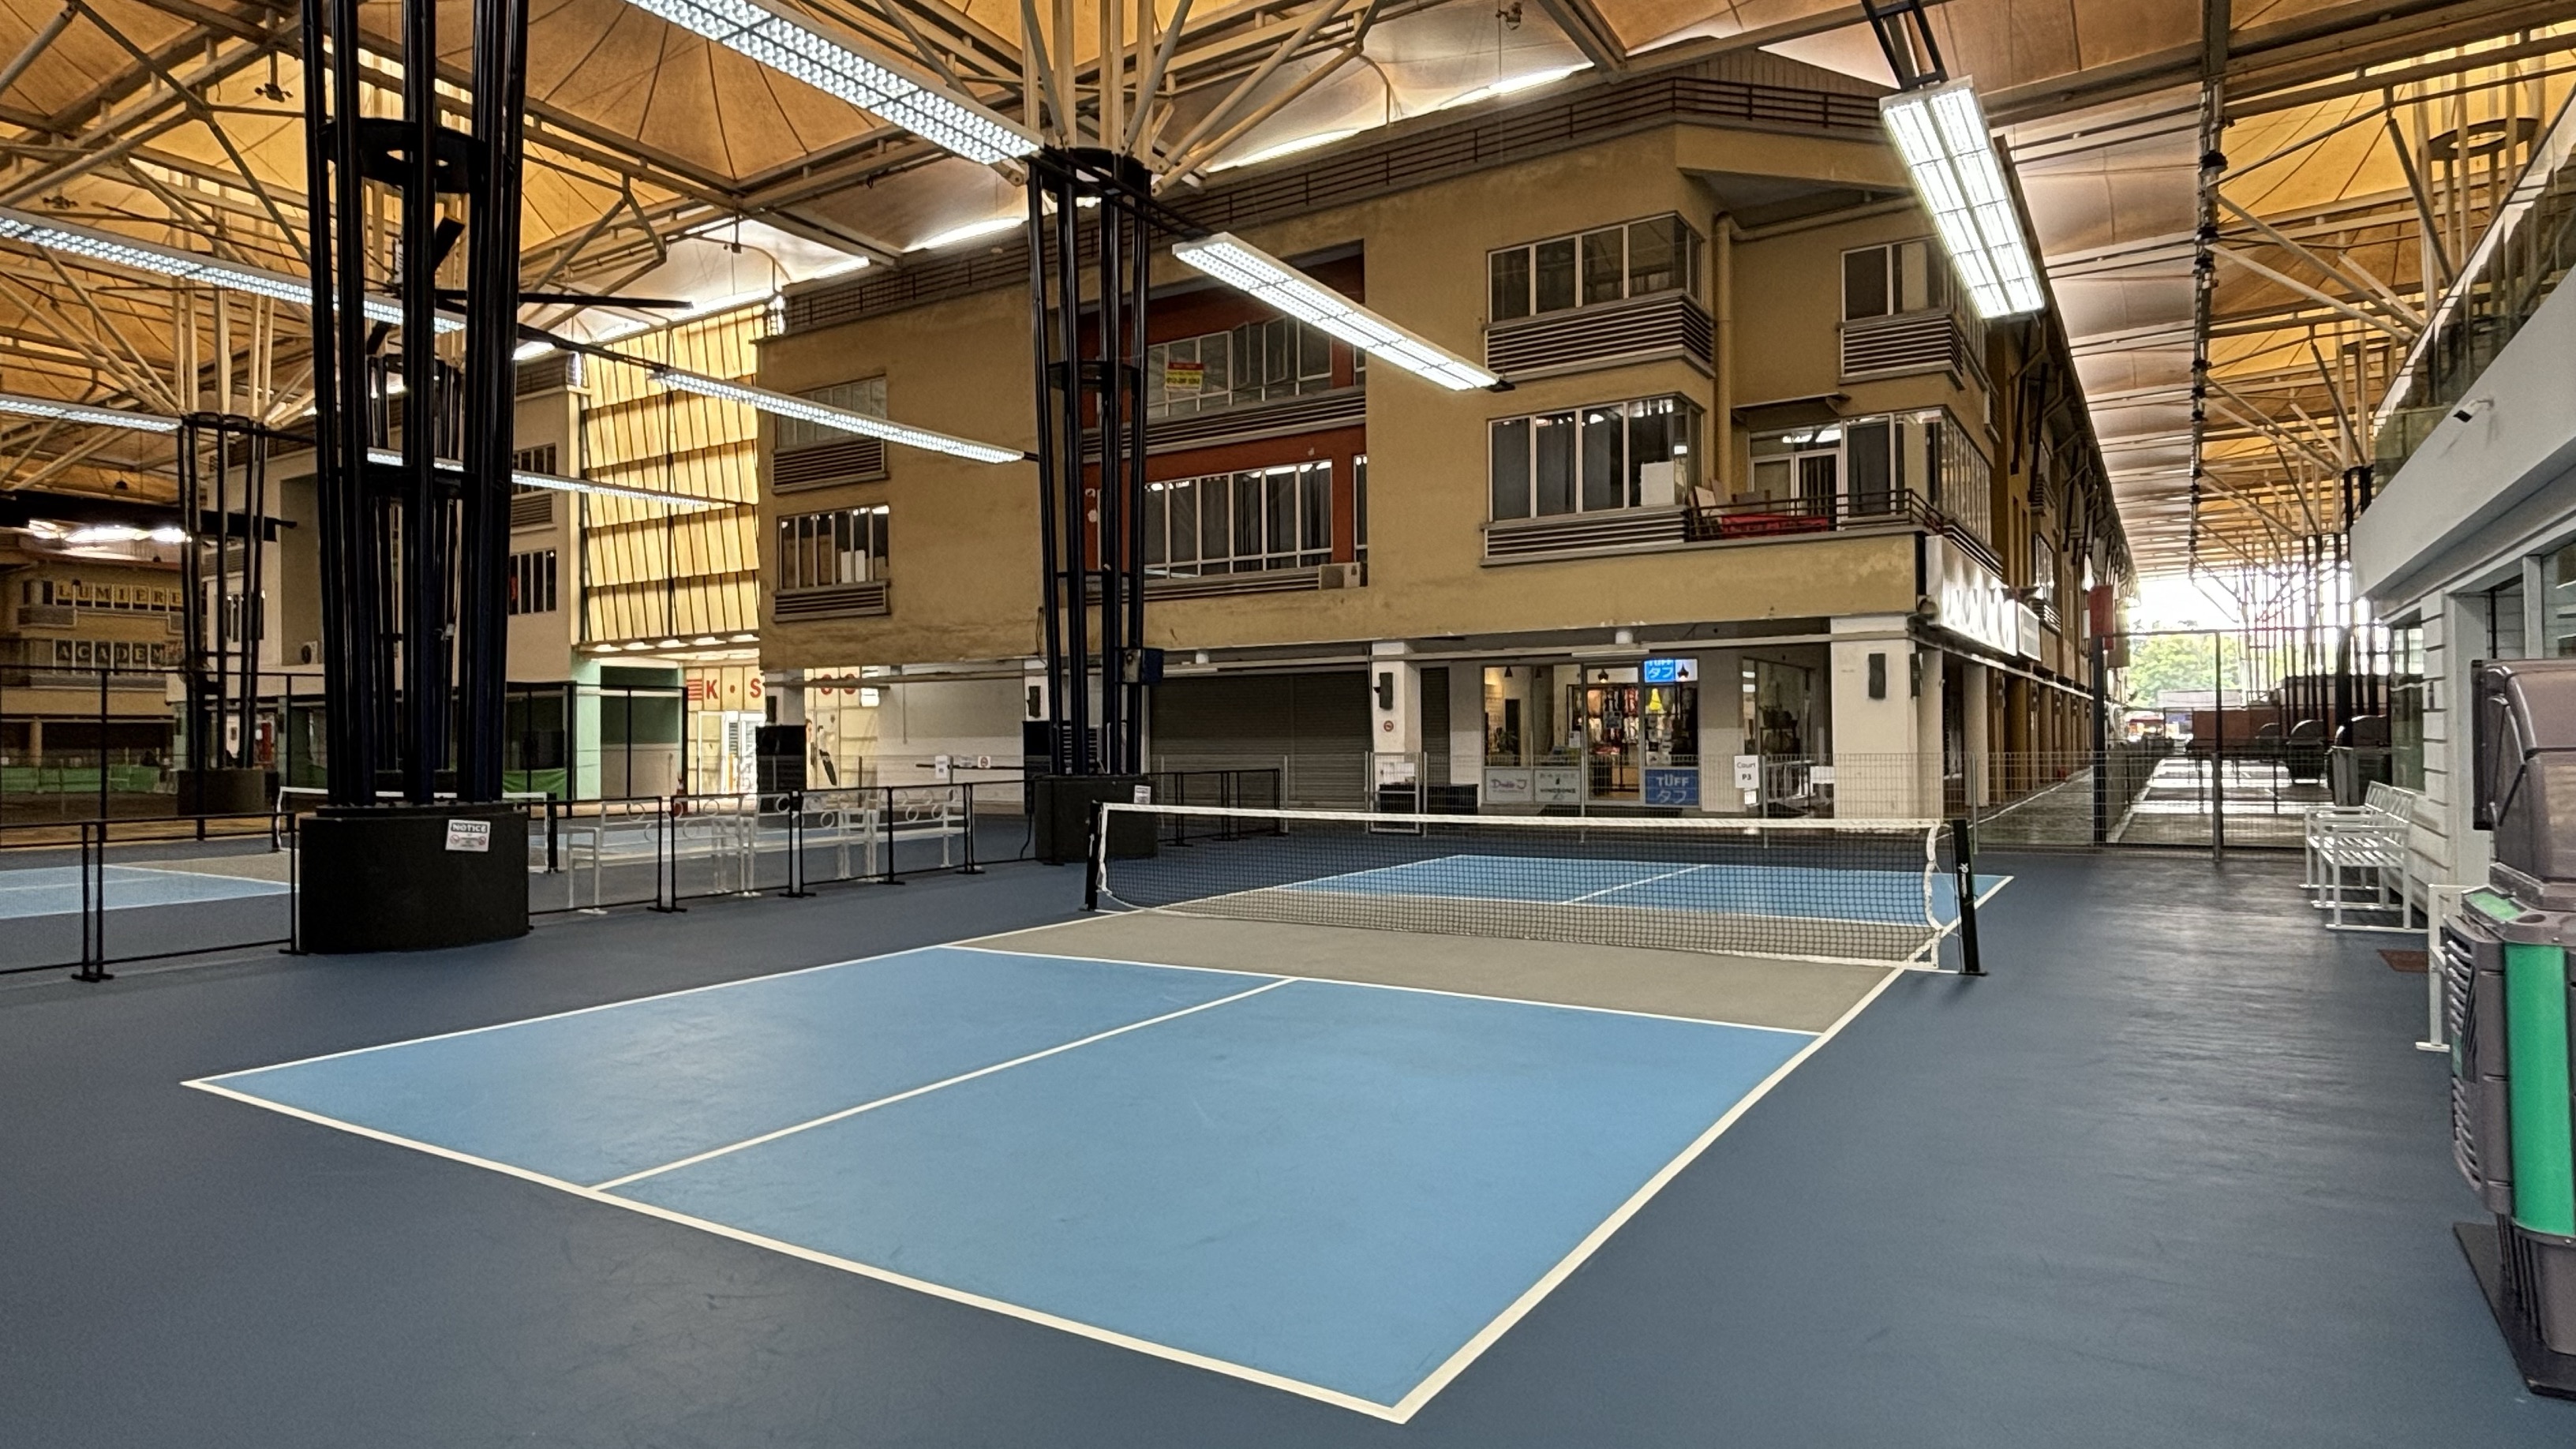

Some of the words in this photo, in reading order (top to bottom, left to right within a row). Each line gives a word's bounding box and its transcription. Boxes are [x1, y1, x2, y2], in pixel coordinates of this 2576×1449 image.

[58, 585, 182, 603] LUMIERE
[57, 645, 164, 660] ACADEM
[452, 823, 487, 833] NOTICE
